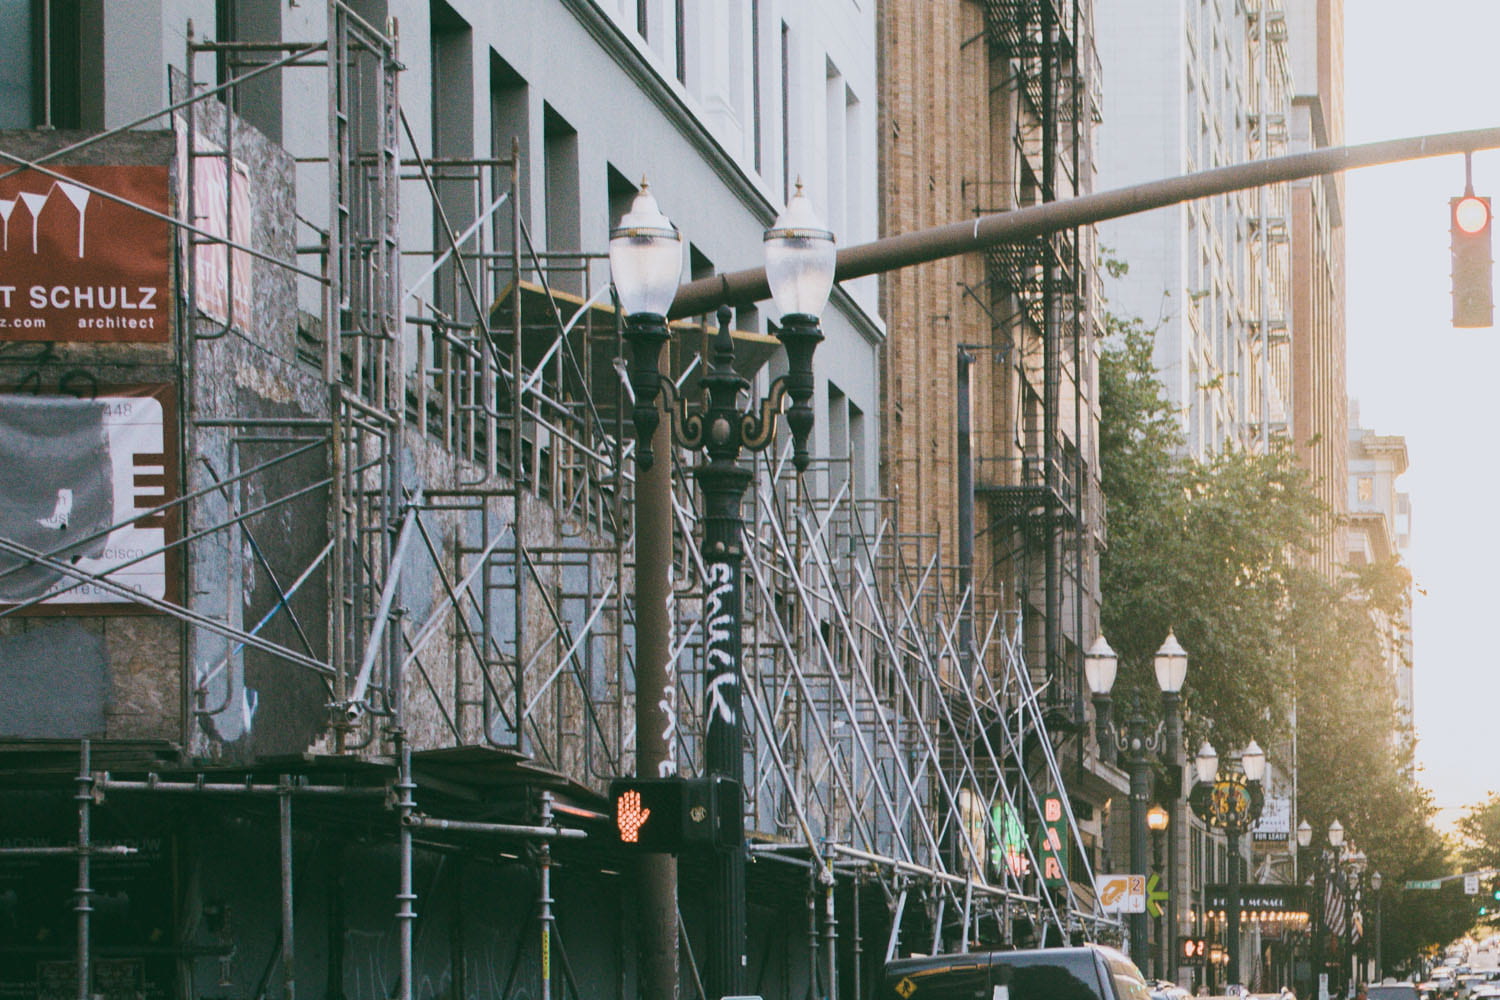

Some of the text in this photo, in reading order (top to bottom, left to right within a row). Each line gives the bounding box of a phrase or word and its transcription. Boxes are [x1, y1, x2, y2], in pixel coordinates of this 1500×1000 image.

[0, 285, 157, 309] T SCHULZ
[0, 316, 154, 329] z.com architect
[103, 403, 132, 416] 448
[104, 547, 144, 559] cisco
[1043, 798, 1061, 880] BAR
